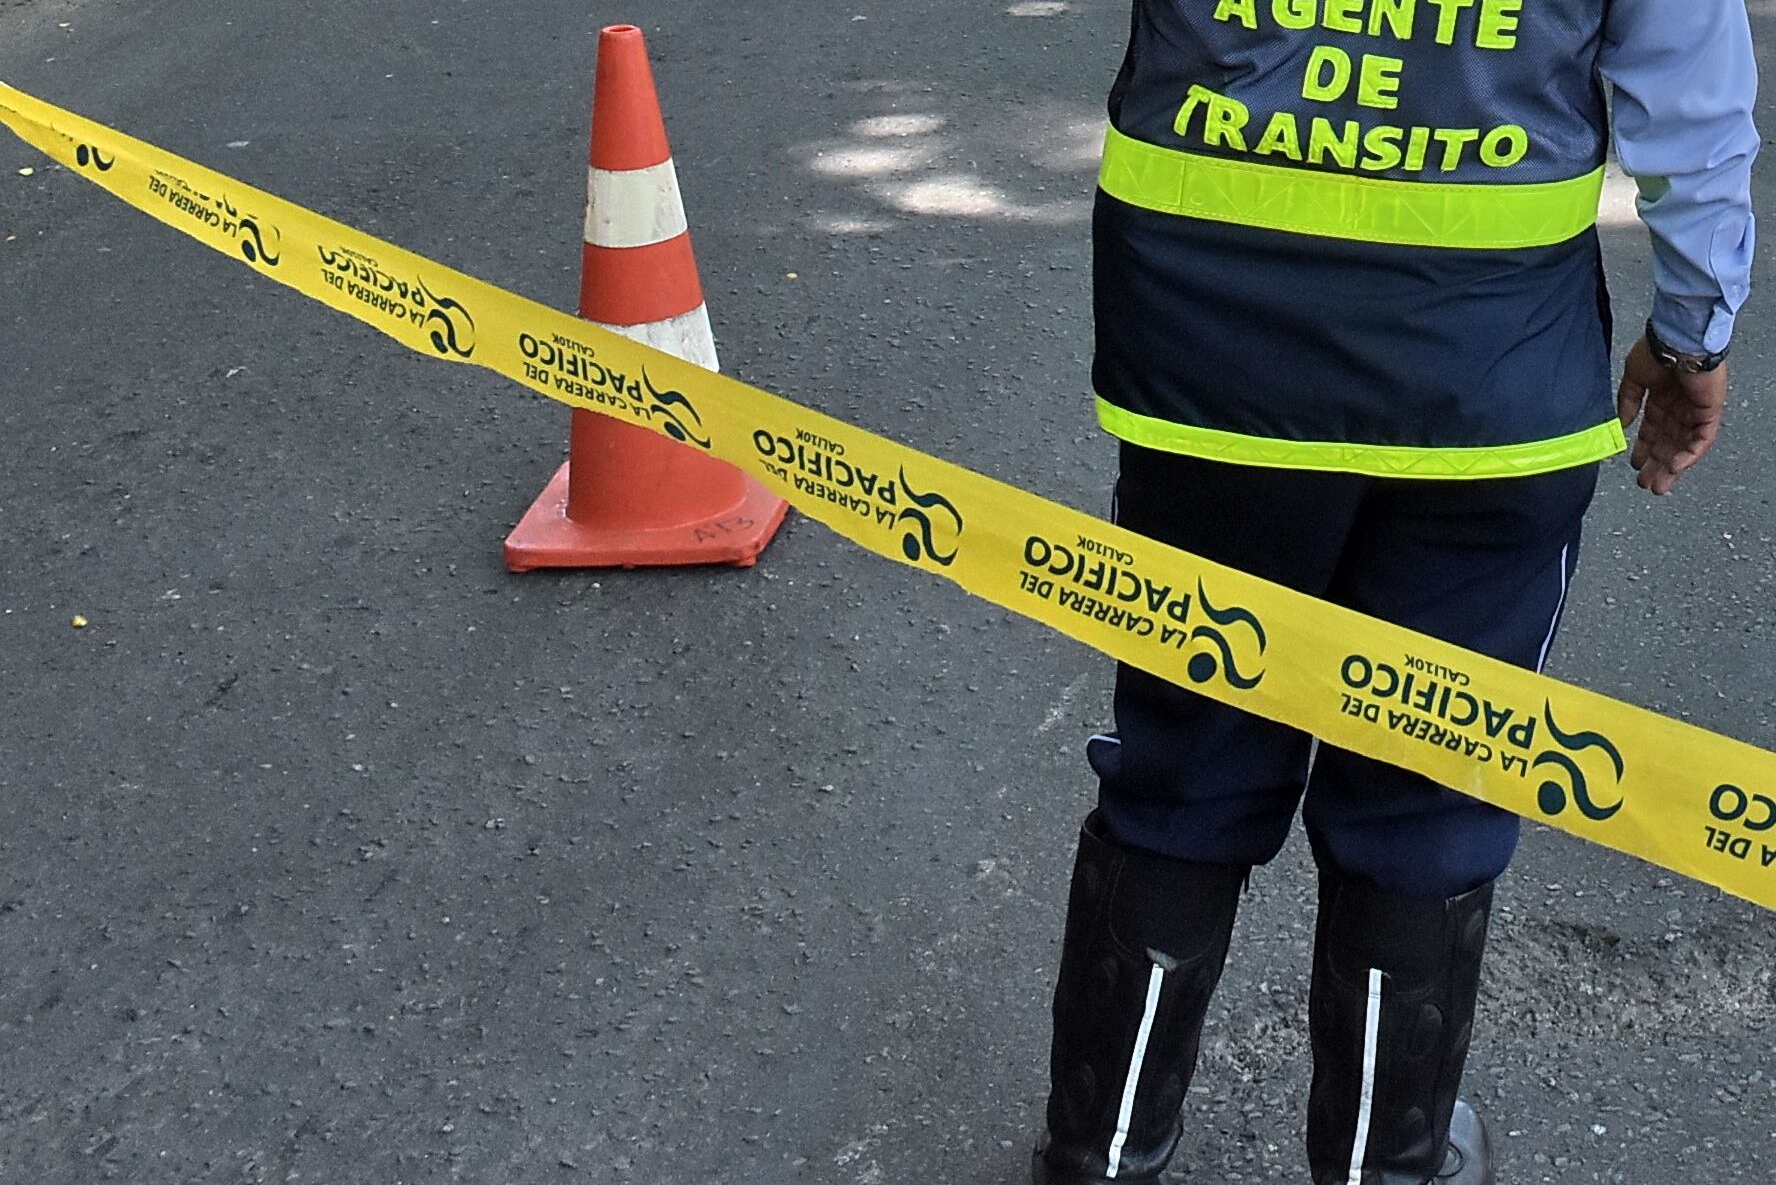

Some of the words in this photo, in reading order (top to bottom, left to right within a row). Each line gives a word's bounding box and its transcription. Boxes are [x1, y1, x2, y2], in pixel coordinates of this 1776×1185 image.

[1302, 46, 1401, 110] DE
[1171, 85, 1529, 172] TRANSITO
[148, 175, 168, 198] DEL
[168, 189, 220, 227] CARRERA
[224, 218, 238, 238] LA
[320, 268, 344, 290] DEL
[347, 280, 407, 319] CARRERA
[409, 309, 426, 328] LA
[552, 333, 595, 357] CALI10K
[518, 333, 644, 403] PACIFICO
[522, 361, 549, 385] DEL
[553, 374, 628, 410] CARRERA
[630, 403, 651, 421] LA
[795, 428, 845, 456] CALI10K
[752, 429, 897, 506] PACIFICO
[793, 473, 871, 517] CARRERA
[875, 506, 897, 530] LA
[1076, 535, 1134, 566] CALI10K
[1019, 570, 1055, 600] DEL
[1023, 535, 1192, 625] PACIFICO
[1058, 586, 1155, 637] CARRERA
[1160, 624, 1188, 650] LA
[1404, 654, 1470, 687] CALI10K
[1340, 654, 1537, 750] PACIFICO
[1340, 692, 1381, 724] DEL
[1387, 709, 1493, 763] CARRERA
[1500, 750, 1529, 778] LA
[1704, 825, 1753, 860] DEL
